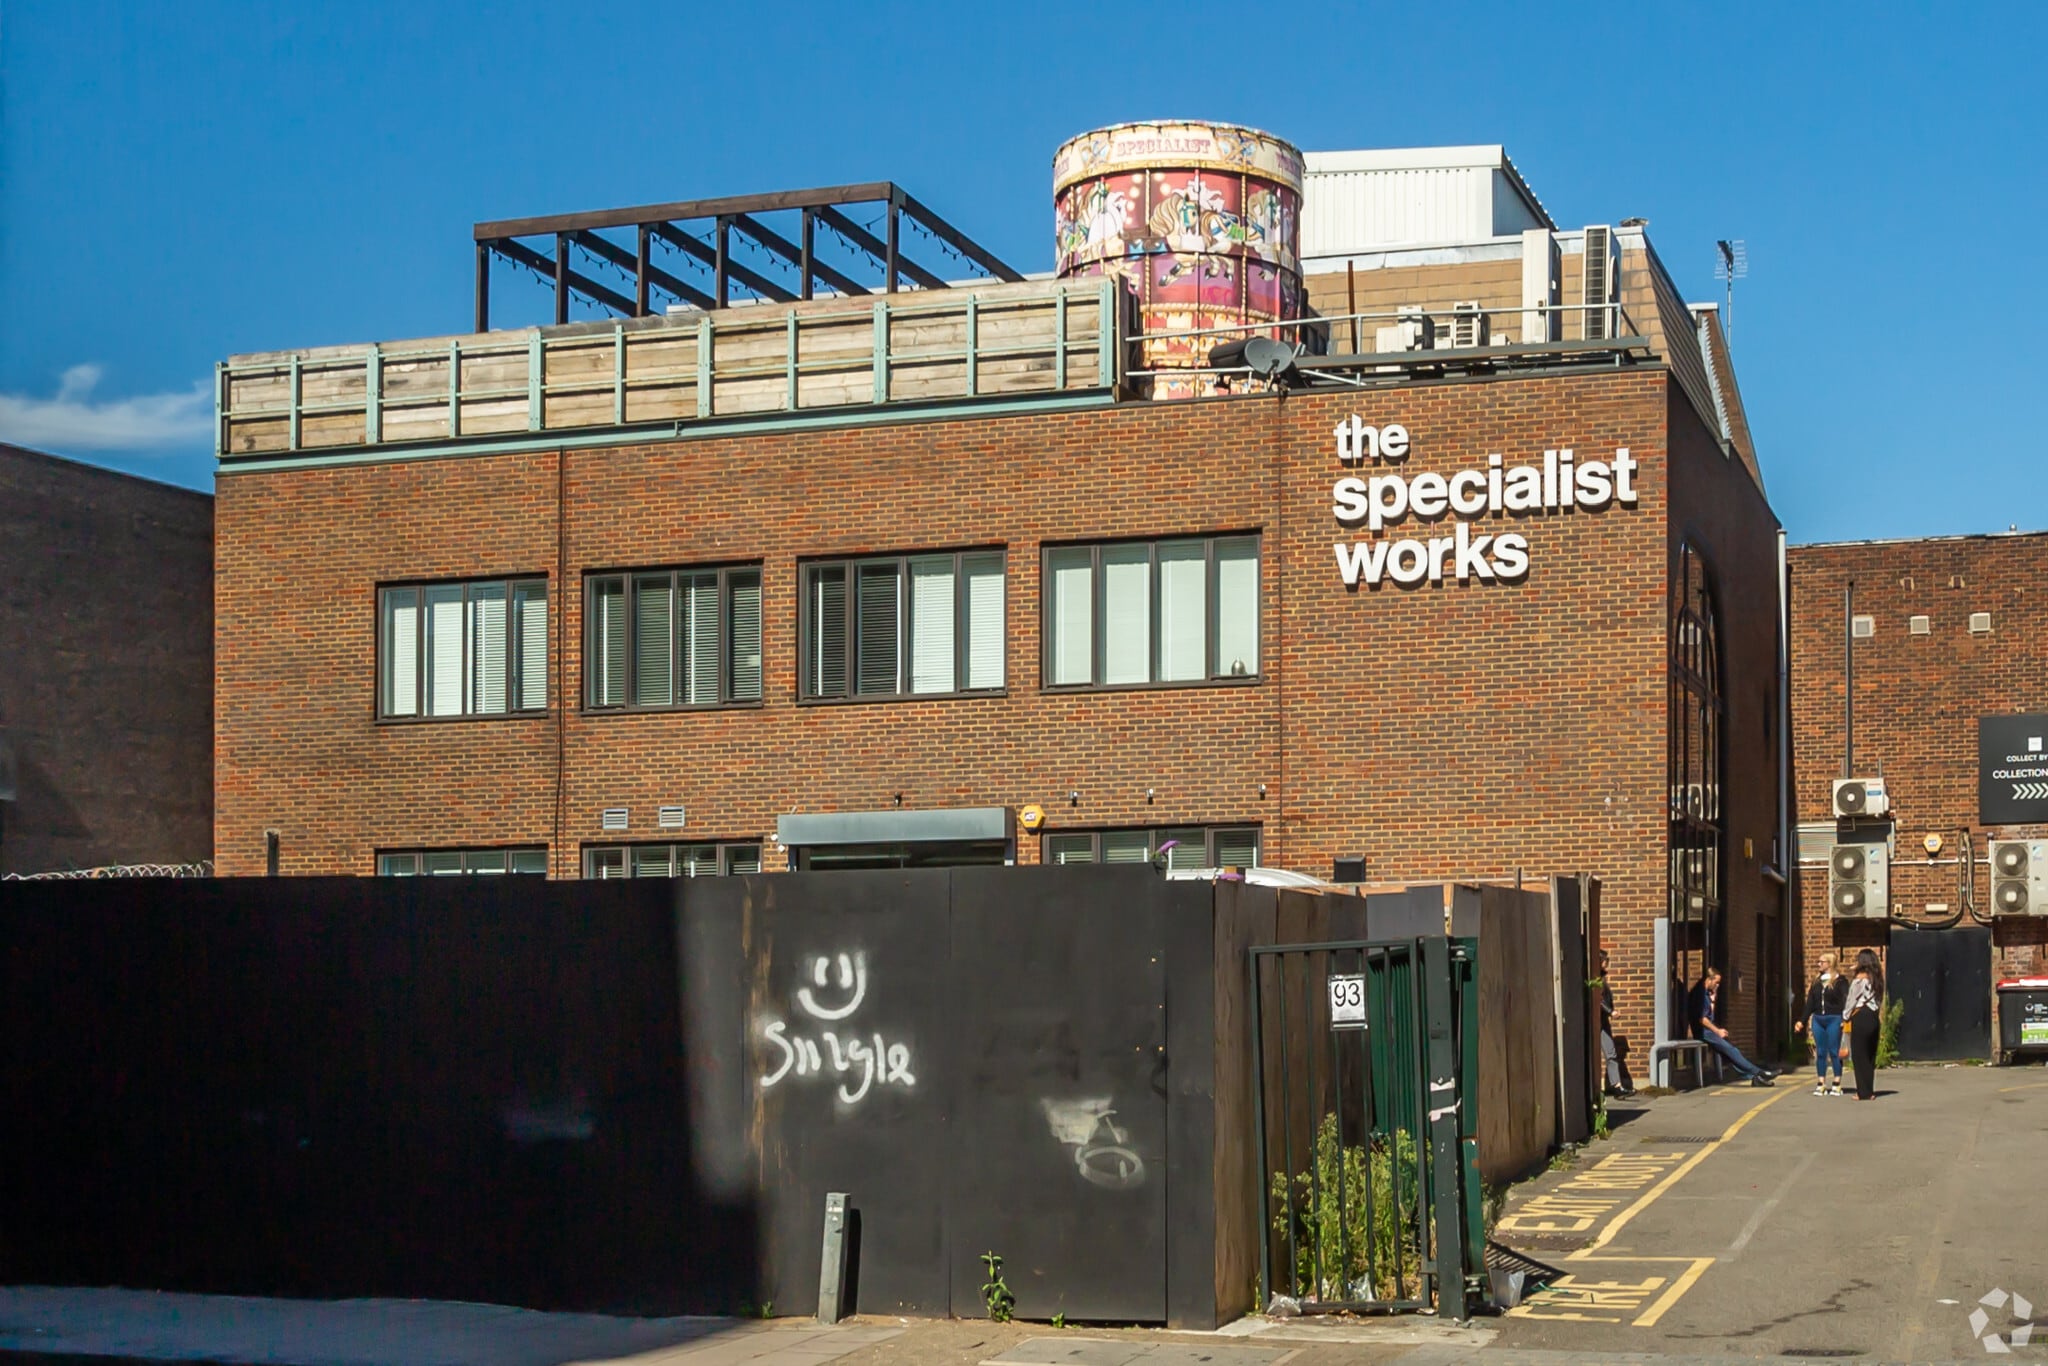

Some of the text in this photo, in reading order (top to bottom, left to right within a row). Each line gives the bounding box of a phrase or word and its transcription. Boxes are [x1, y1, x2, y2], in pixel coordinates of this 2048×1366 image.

[1117, 138, 1211, 156] SPECIALIST
[1333, 413, 1409, 460] the
[1332, 448, 1638, 531] specialist
[1333, 522, 1529, 584] works
[1334, 983, 1360, 1007] 93
[1495, 1152, 1687, 1323] FIRE EXIT ROUTE
